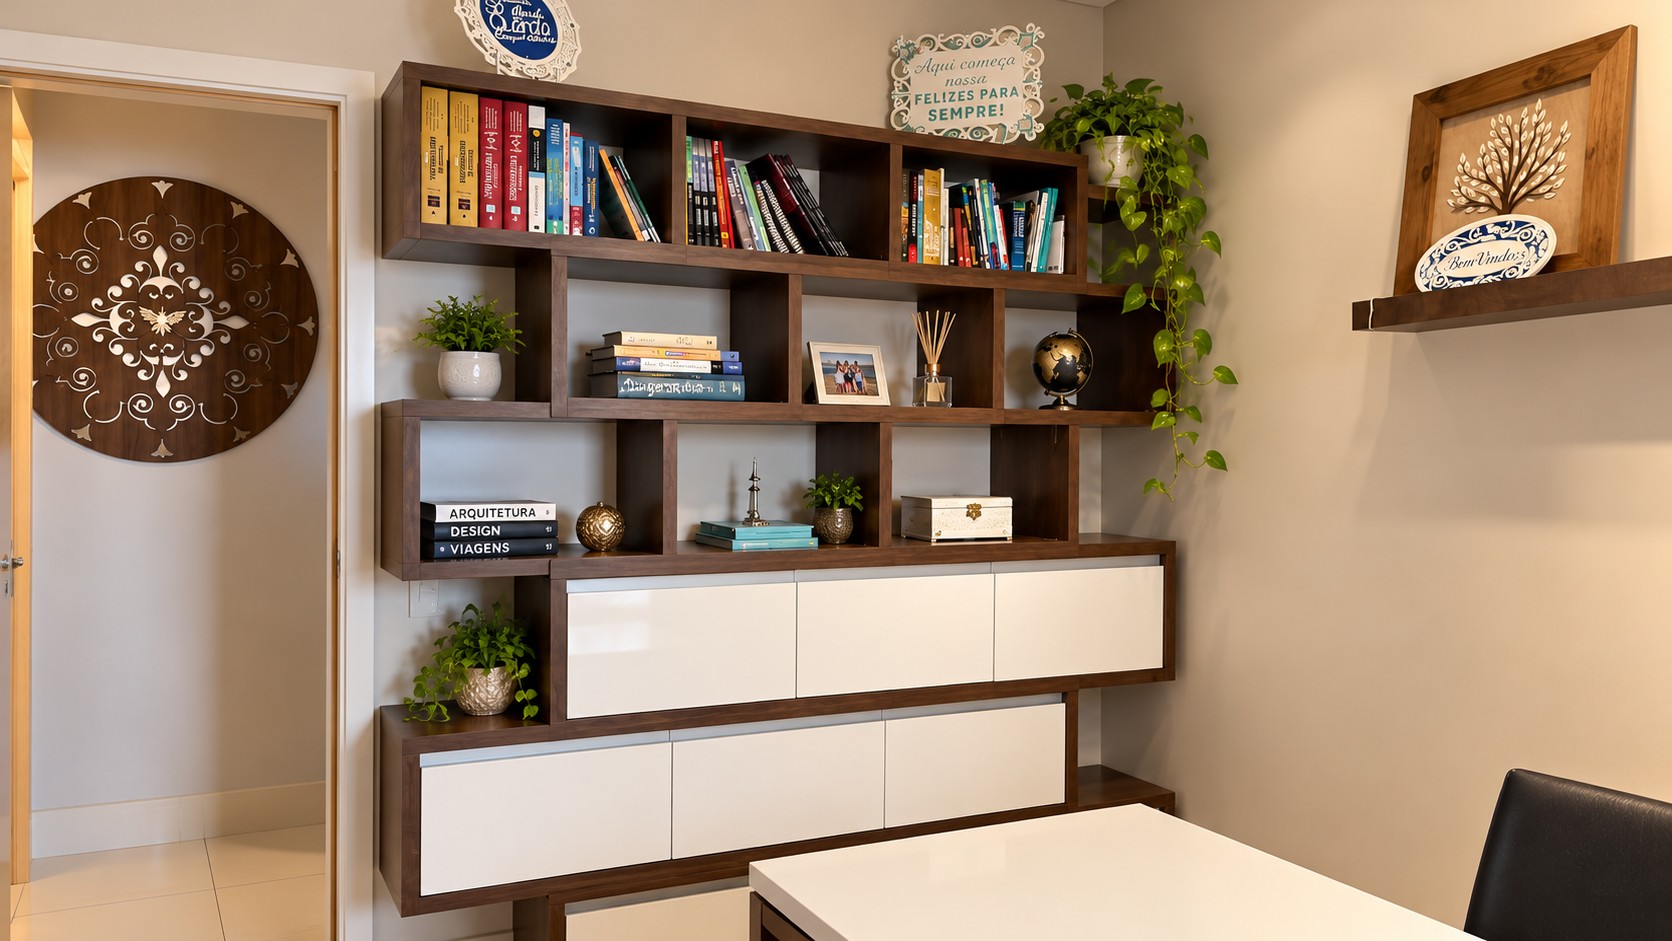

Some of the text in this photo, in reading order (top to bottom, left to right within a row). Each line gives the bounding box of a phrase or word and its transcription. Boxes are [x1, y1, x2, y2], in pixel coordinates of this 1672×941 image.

[914, 56, 1016, 76] Aqui começa
[945, 74, 987, 87] nossa
[980, 86, 1019, 99] PARA
[928, 104, 1004, 122] SEMPRE!
[450, 507, 536, 520] ARQUITETURA
[450, 525, 501, 537] DESIGN
[450, 542, 510, 555] VIAGENS
